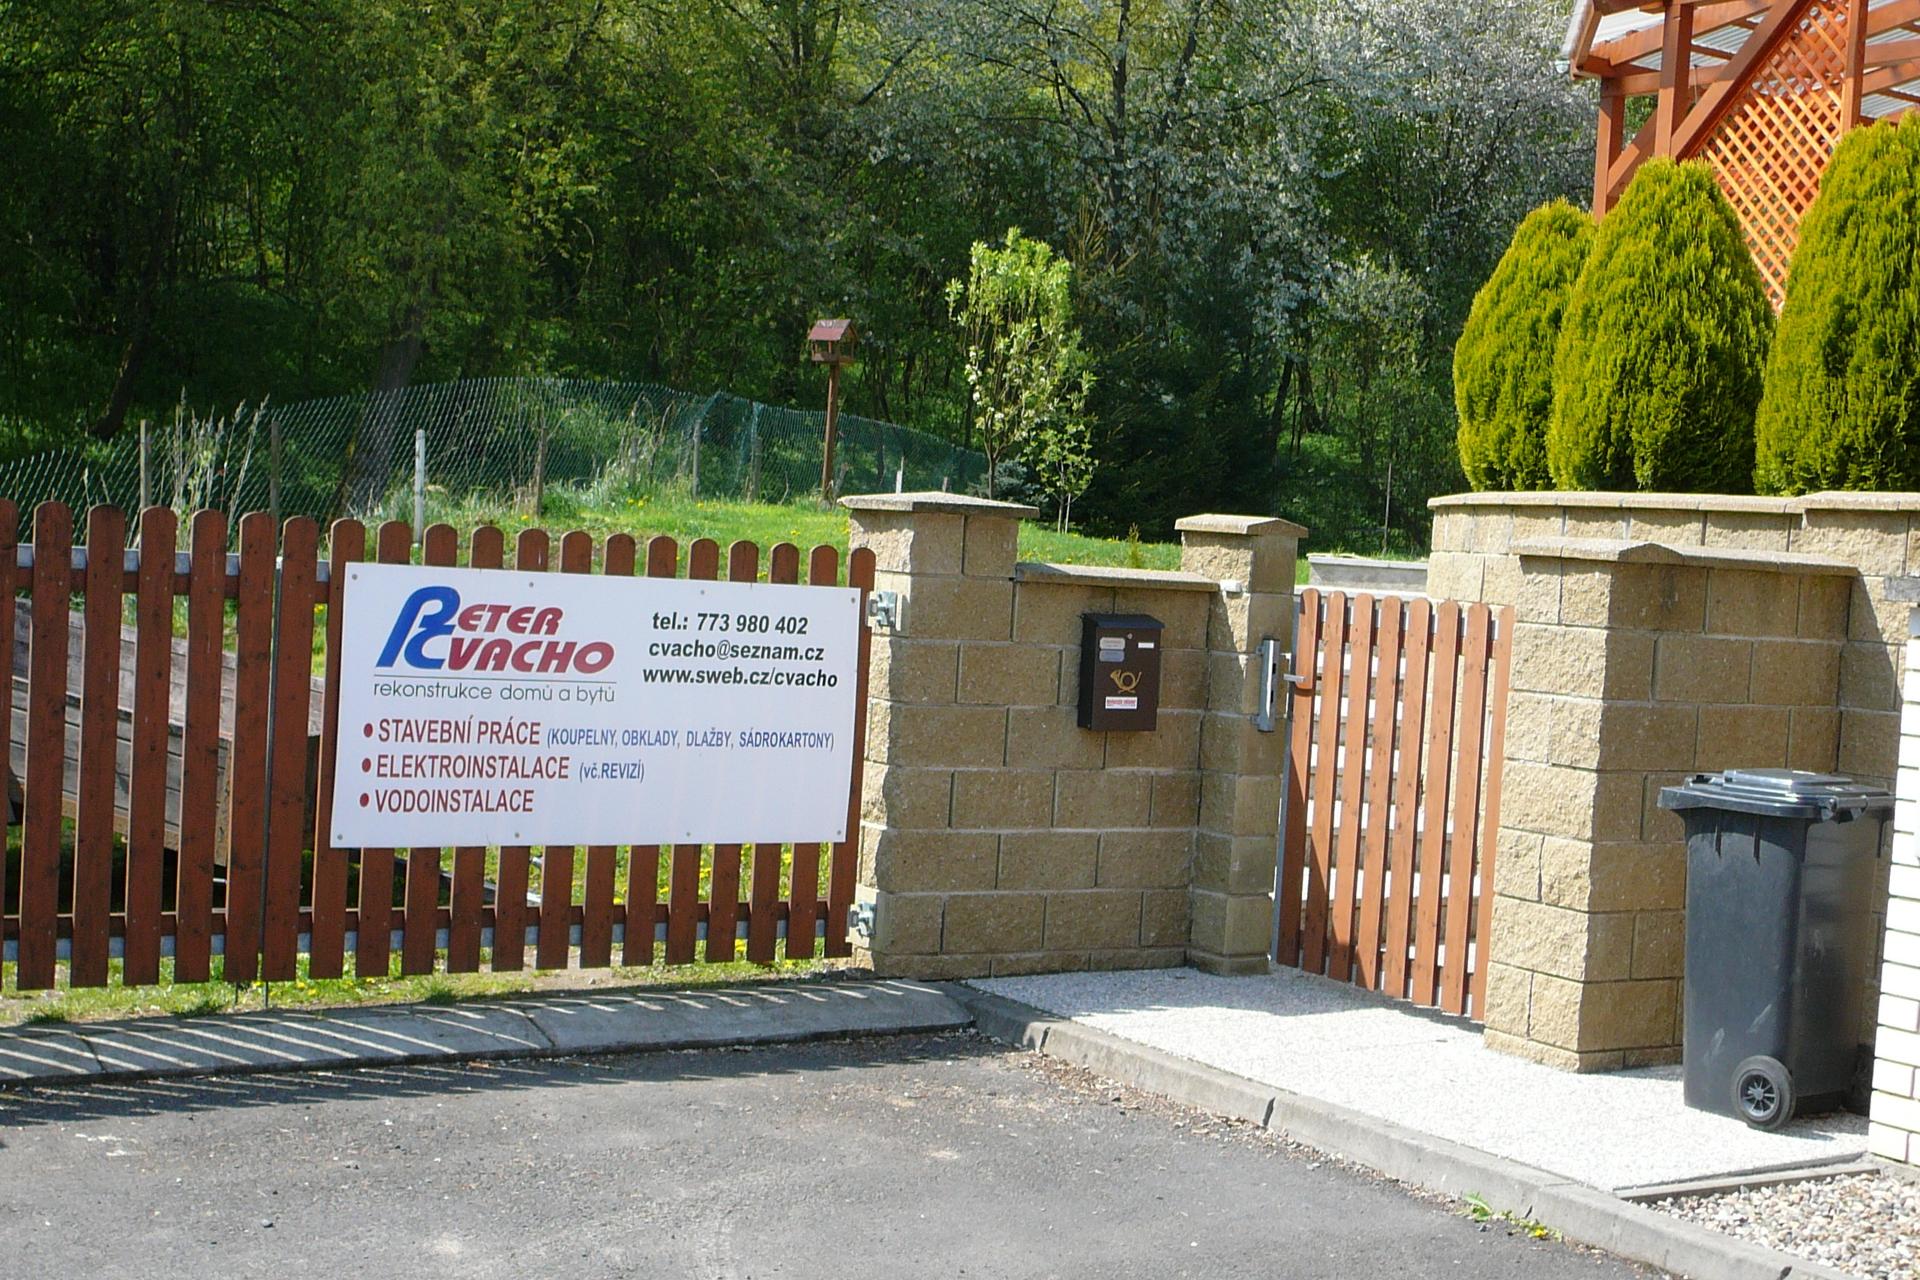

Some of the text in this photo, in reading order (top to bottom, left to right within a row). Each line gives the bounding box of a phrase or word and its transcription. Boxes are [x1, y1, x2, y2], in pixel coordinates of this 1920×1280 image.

[375, 585, 563, 667] PETER
[652, 612, 808, 635] tel.: 773 980 402
[404, 628, 615, 674] CVACHO
[648, 640, 825, 661] cvacho@seznam.cz
[643, 667, 838, 688] www.sweb.cz/cvacho
[373, 680, 615, 706] rekonstrukce domů a bytů
[378, 715, 835, 751] STAVEBNÍ PRÁCE (KOUPELNY, OBKLADY, DLAŽBY, SÁDROKARTONY)
[376, 754, 570, 779] ELEKTROINSTALACE
[374, 789, 535, 813] VODOINSTALACE
